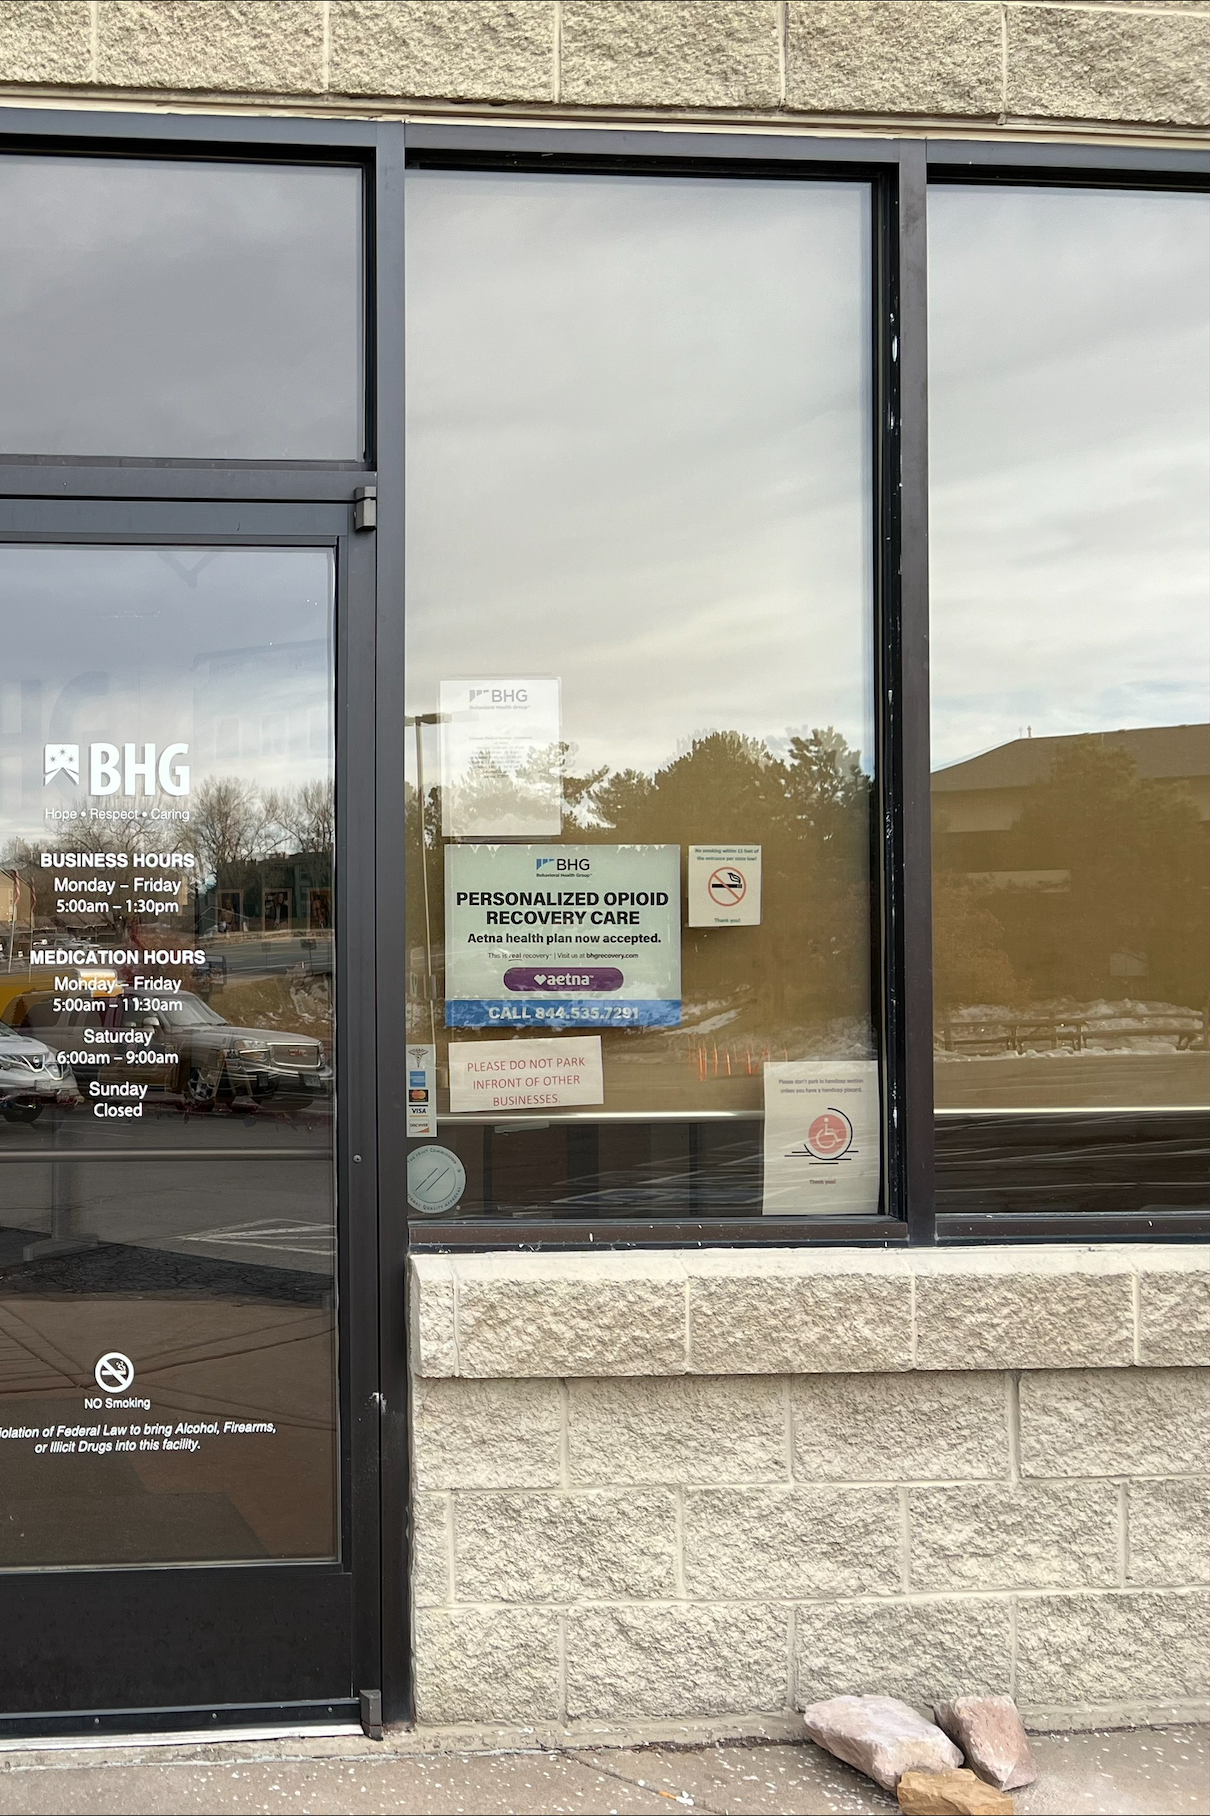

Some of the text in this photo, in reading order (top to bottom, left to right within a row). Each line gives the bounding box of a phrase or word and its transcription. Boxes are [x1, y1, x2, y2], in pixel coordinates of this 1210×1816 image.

[492, 689, 528, 702] BHG
[91, 742, 190, 796] BHG
[45, 808, 189, 822] Hope Respect Caring
[40, 853, 195, 868] BUSINESS HOURS
[557, 858, 590, 871] BHG
[54, 877, 115, 895] Monday
[134, 877, 181, 895] Friday
[456, 892, 669, 906] PERSONALIZED OPIOID
[56, 899, 109, 913] 5:00am
[126, 899, 178, 916] 1:30pm
[486, 910, 640, 925] RECOVERY CARE
[468, 933, 662, 945] Aetna health plan now accepted.
[30, 950, 206, 965] MEDICATION HOURS
[586, 952, 639, 960] bhgrecovery.com
[54, 976, 115, 994] Monday
[134, 976, 182, 994] Friday
[547, 973, 590, 986] aetna
[53, 998, 105, 1012] 5:00am
[122, 997, 182, 1012] 11:30am
[489, 1006, 639, 1019] CALL 844.535.7291
[83, 1028, 153, 1046] Saturday
[57, 1050, 110, 1064] 6:00am
[126, 1050, 178, 1064] 9:00am
[467, 1057, 586, 1072] PLEASE DO NOT PARK
[89, 1081, 148, 1098] Sunday
[473, 1075, 580, 1090] INFRONT OF OTHER
[493, 1094, 561, 1107] BUSINESSES.
[93, 1103, 143, 1117] Closed
[84, 1397, 151, 1411] NO Smoking
[42, 1426, 54, 1438] of
[56, 1424, 101, 1438] Federal
[103, 1424, 128, 1436] Law
[129, 1424, 141, 1436] to
[143, 1423, 173, 1437] bring
[174, 1421, 220, 1435] Alcohol,
[223, 1421, 276, 1434] Firearms,
[34, 1437, 201, 1454] or Illicit Drugs into this facility.
